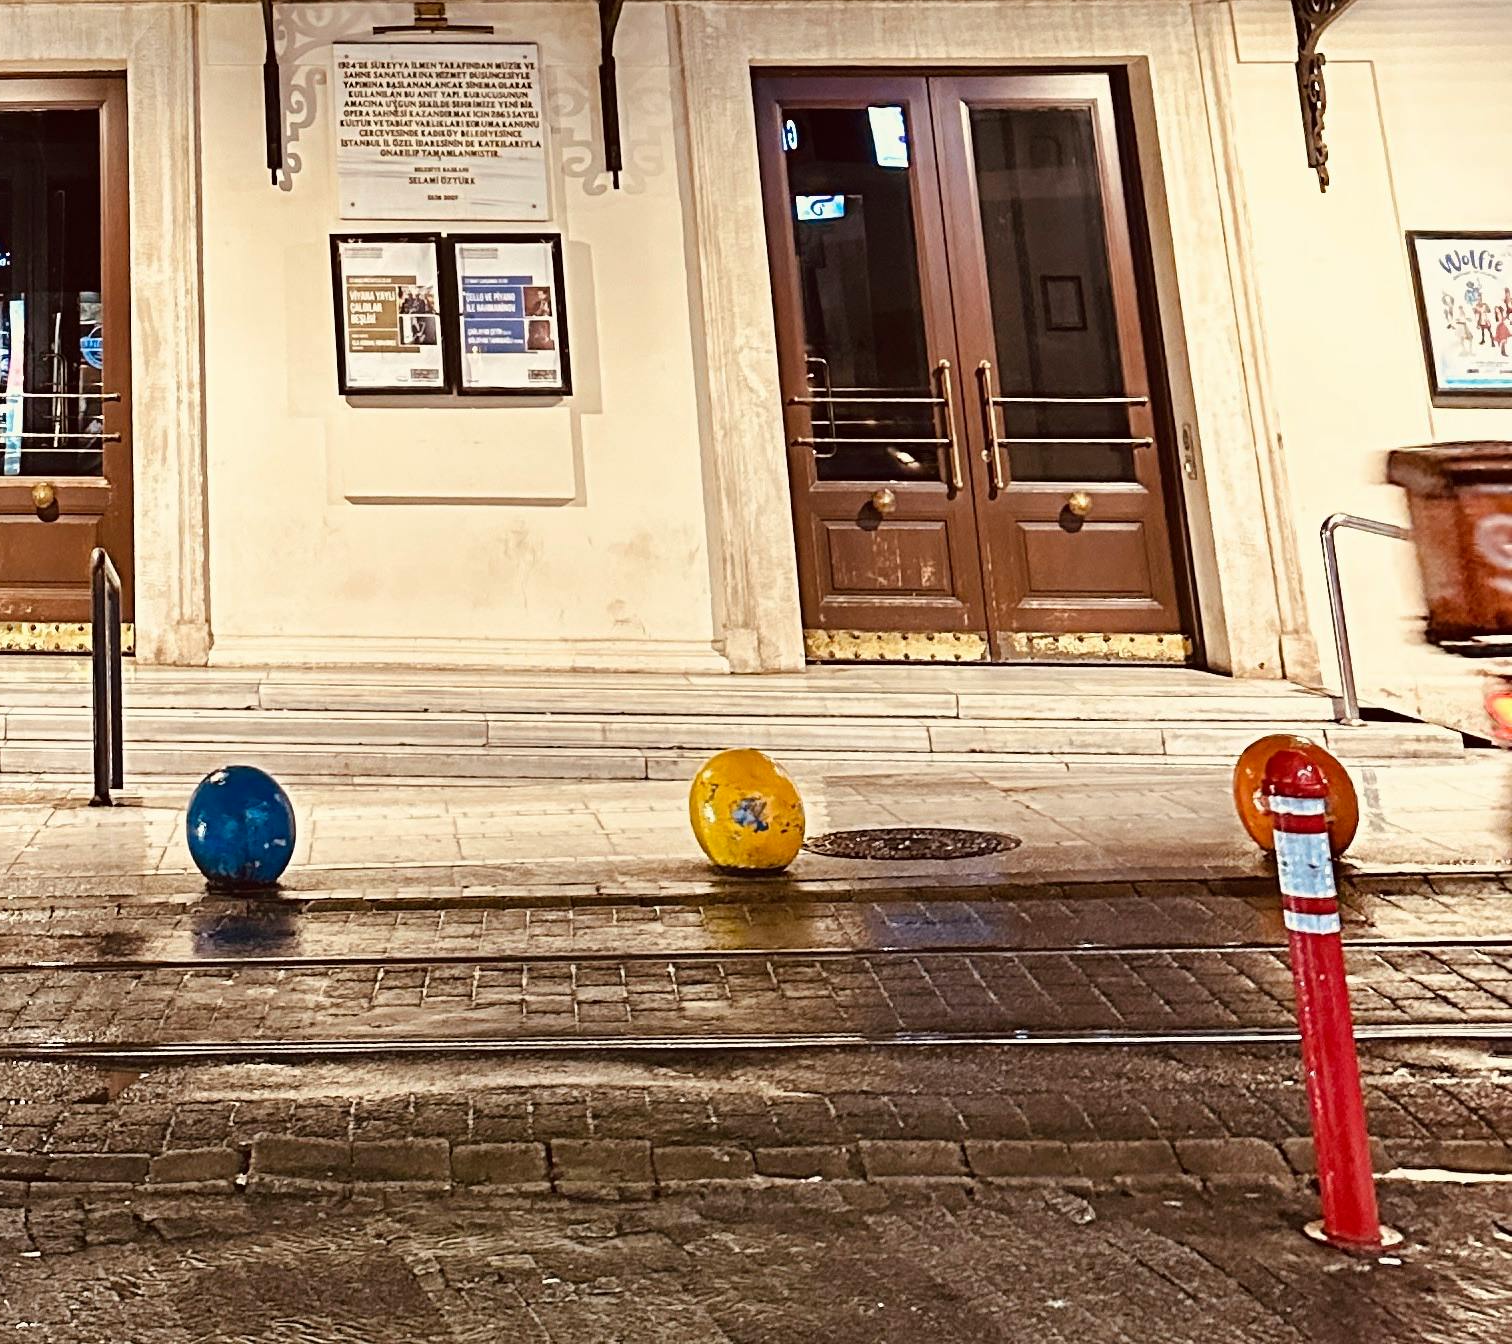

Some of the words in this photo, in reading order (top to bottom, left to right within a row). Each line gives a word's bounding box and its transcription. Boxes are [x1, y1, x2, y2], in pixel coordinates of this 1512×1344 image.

[524, 61, 535, 70] VE
[343, 71, 372, 80] SAHNE
[498, 81, 533, 90] OLARAK
[404, 90, 415, 99] BU
[385, 99, 417, 108] UYGUN
[343, 109, 370, 118] OPERA
[373, 119, 384, 128] VE
[465, 139, 475, 148] DE
[1438, 249, 1504, 274] Wolfie
